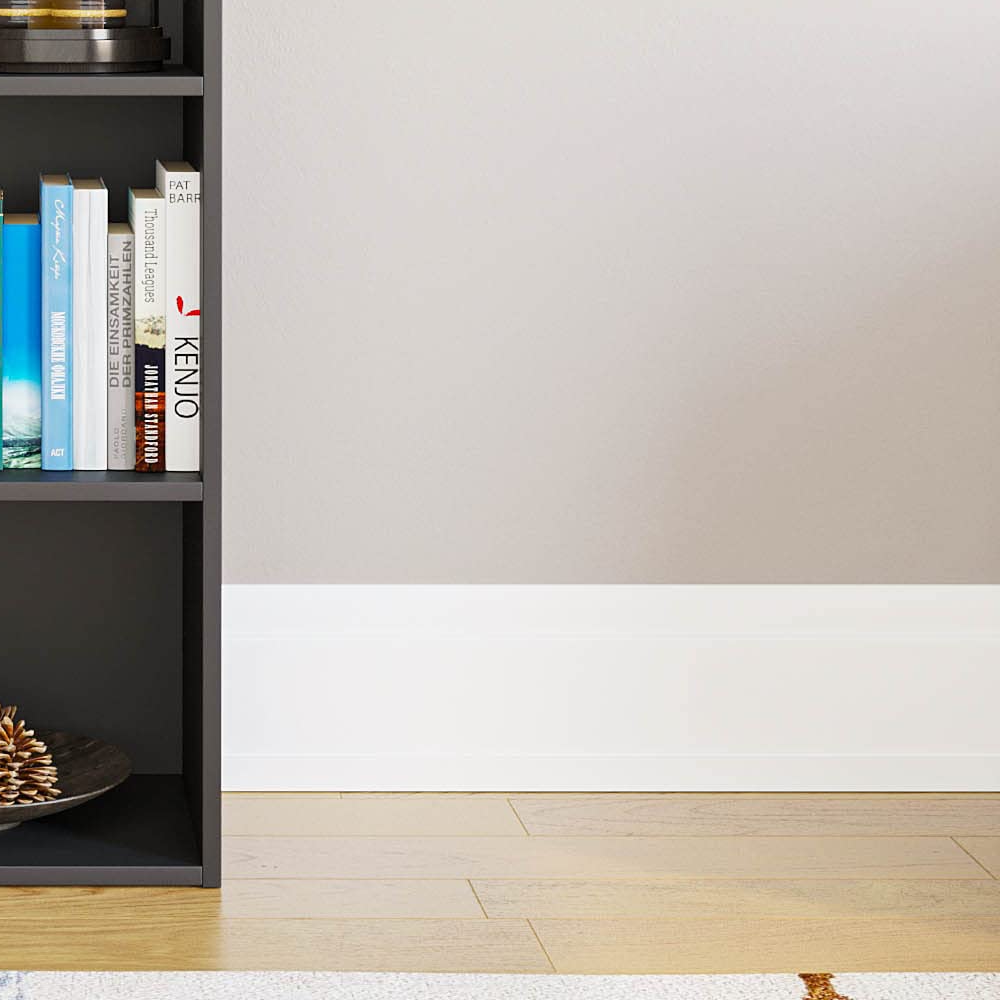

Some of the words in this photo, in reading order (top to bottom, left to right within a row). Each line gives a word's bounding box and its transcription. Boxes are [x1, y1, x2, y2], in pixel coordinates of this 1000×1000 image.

[169, 180, 192, 190] PAT
[144, 208, 158, 259] Thousand
[109, 255, 120, 356] EINSAMKEIT
[121, 240, 132, 349] PRIMZAHLEN
[142, 262, 158, 303] Leagues
[109, 359, 120, 388] DIE
[121, 354, 132, 388] DER
[144, 364, 159, 411] JONATHAN
[174, 336, 200, 419] KENJO
[144, 413, 159, 464] STANDFORD
